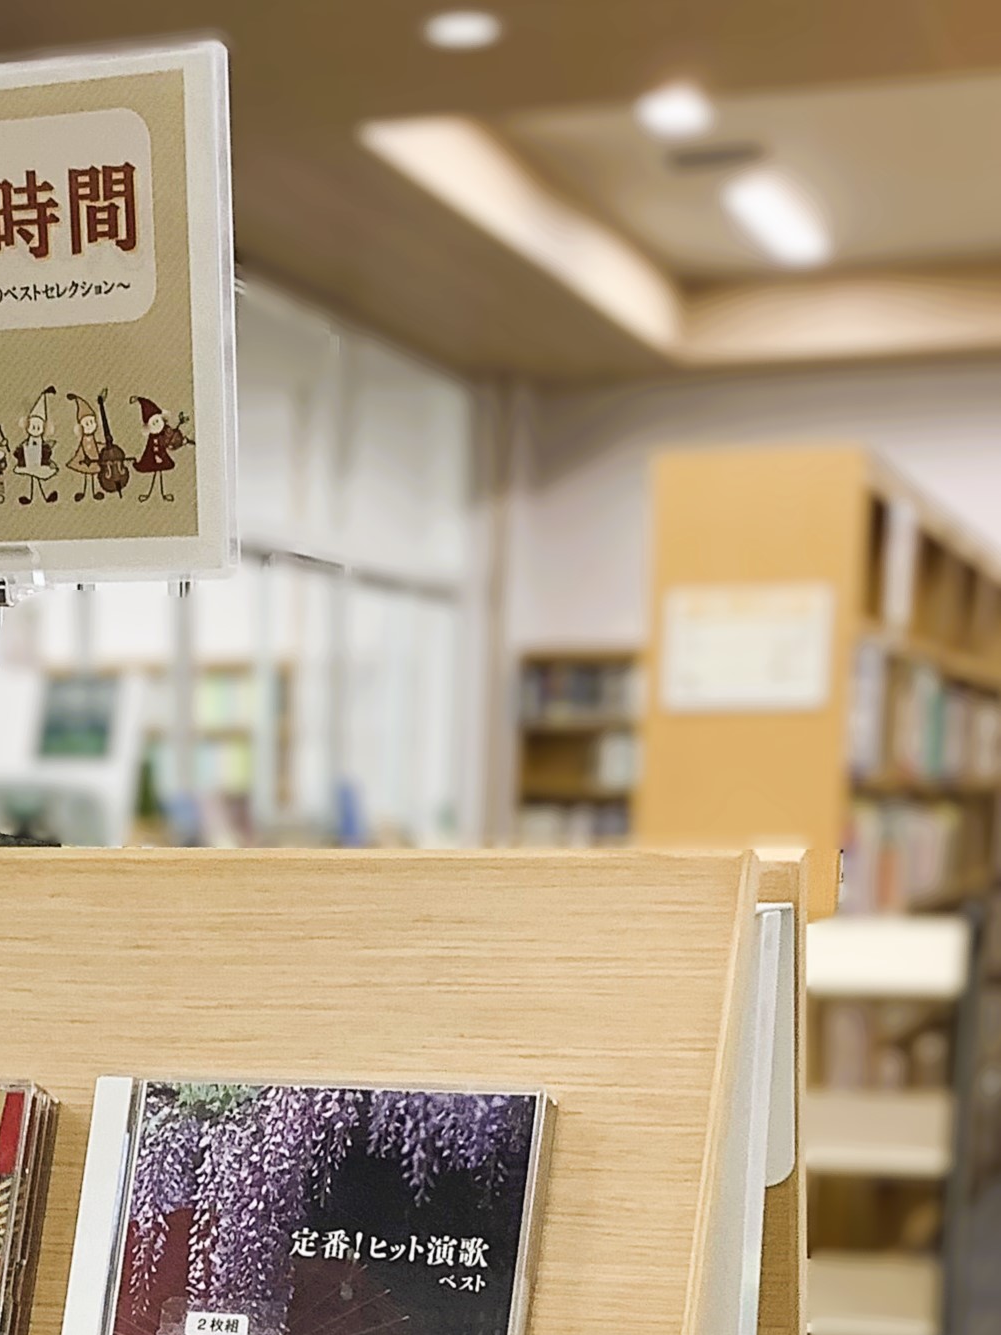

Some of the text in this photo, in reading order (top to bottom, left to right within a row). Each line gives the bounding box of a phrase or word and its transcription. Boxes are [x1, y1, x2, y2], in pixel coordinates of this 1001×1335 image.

[289, 1227, 490, 1268] 定番!ヒット演歌
[438, 1274, 486, 1293] ベスト
[197, 1317, 240, 1334] 2枚組
